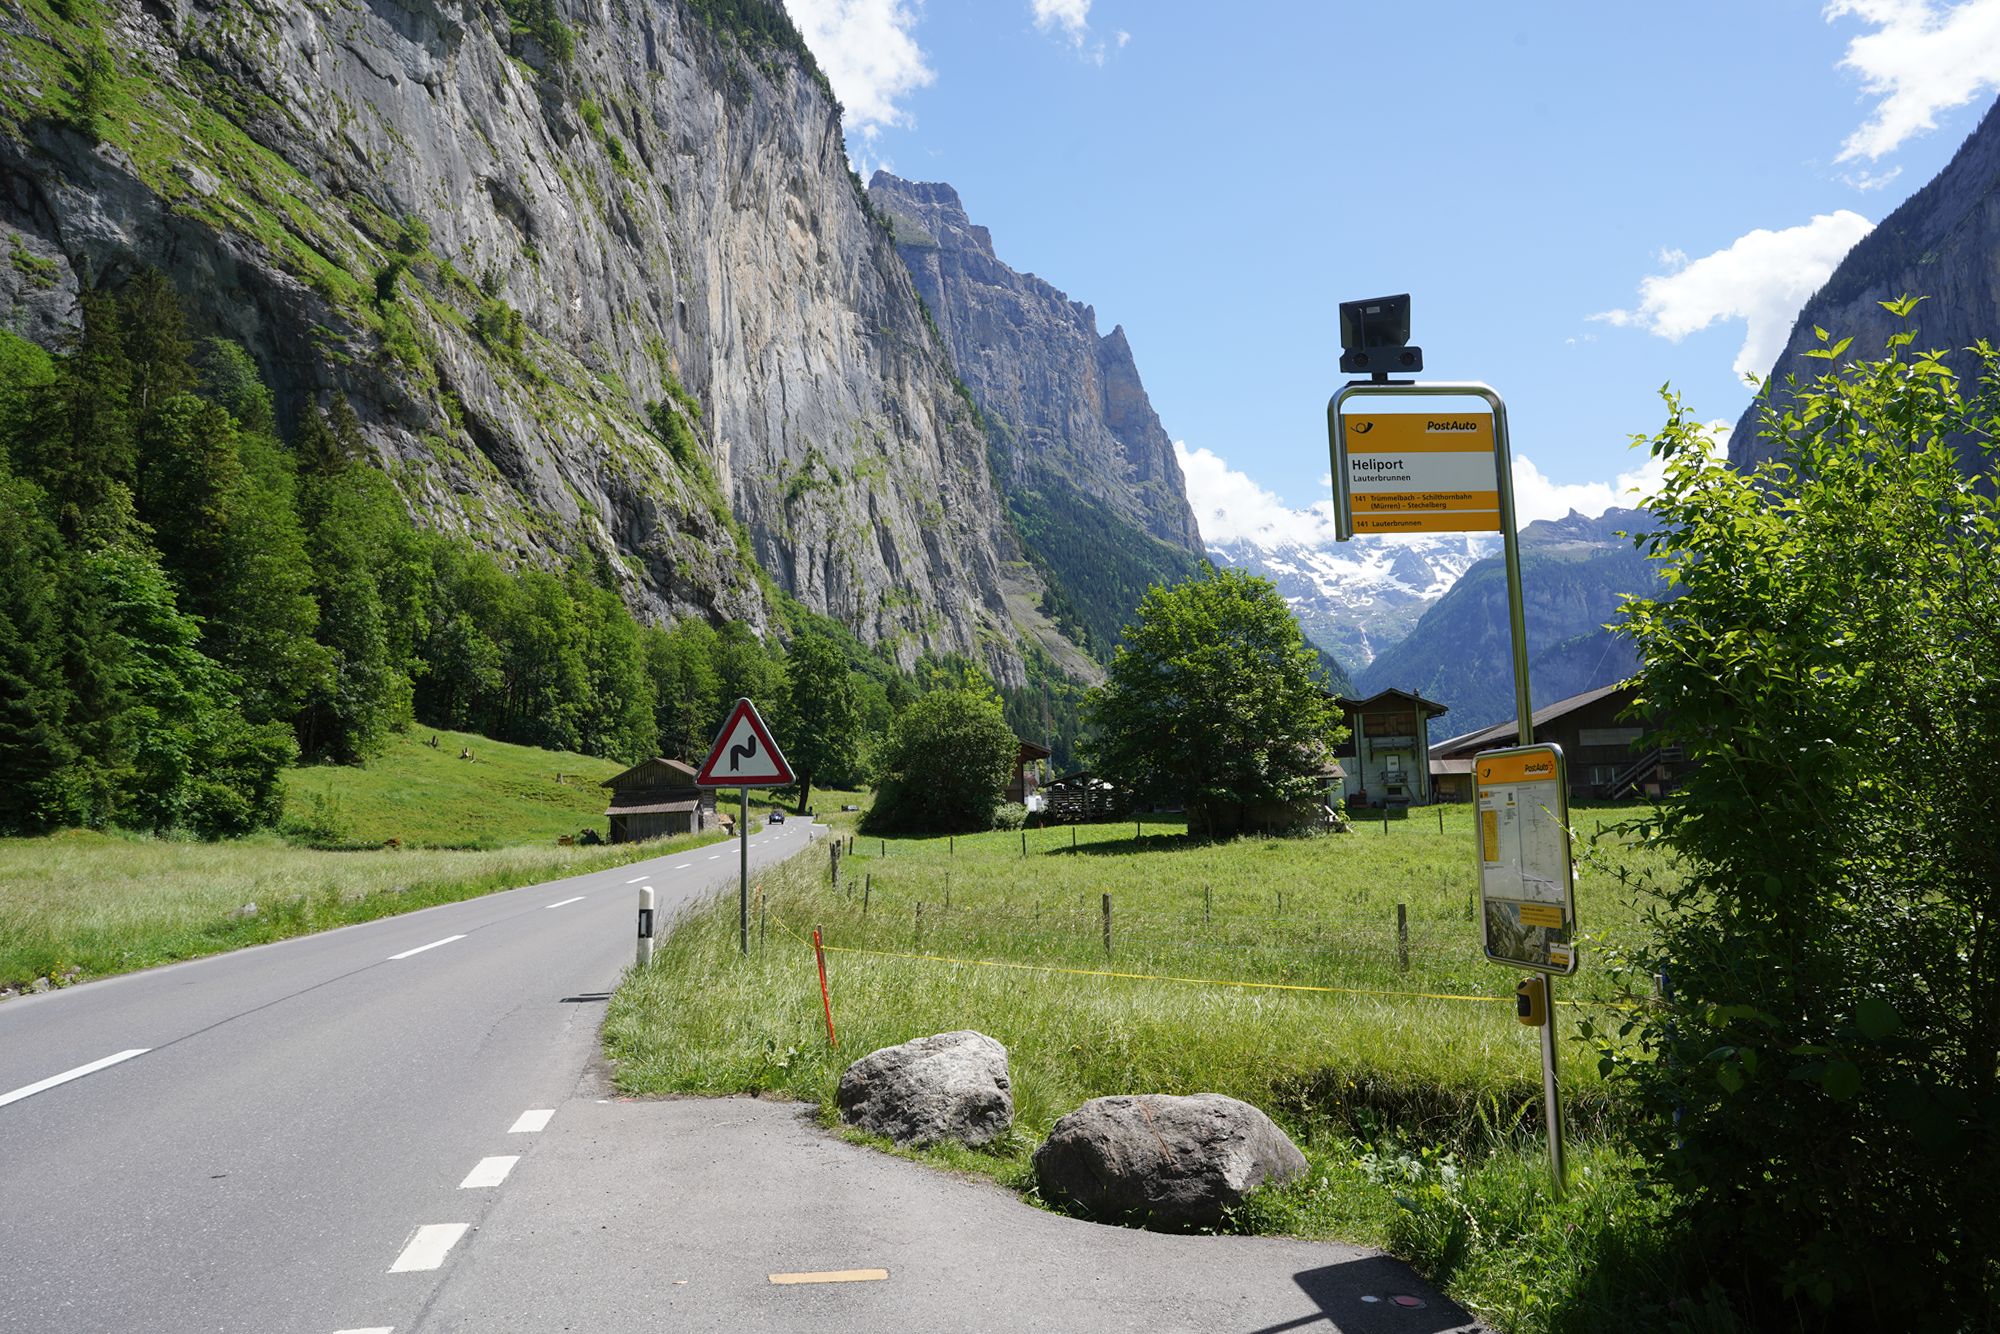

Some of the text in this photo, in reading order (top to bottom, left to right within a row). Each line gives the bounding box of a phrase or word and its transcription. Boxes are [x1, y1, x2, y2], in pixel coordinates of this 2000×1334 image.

[1427, 421, 1477, 431] PostAuto
[1352, 459, 1404, 472] Heliport
[1525, 763, 1548, 772] PostAuto
